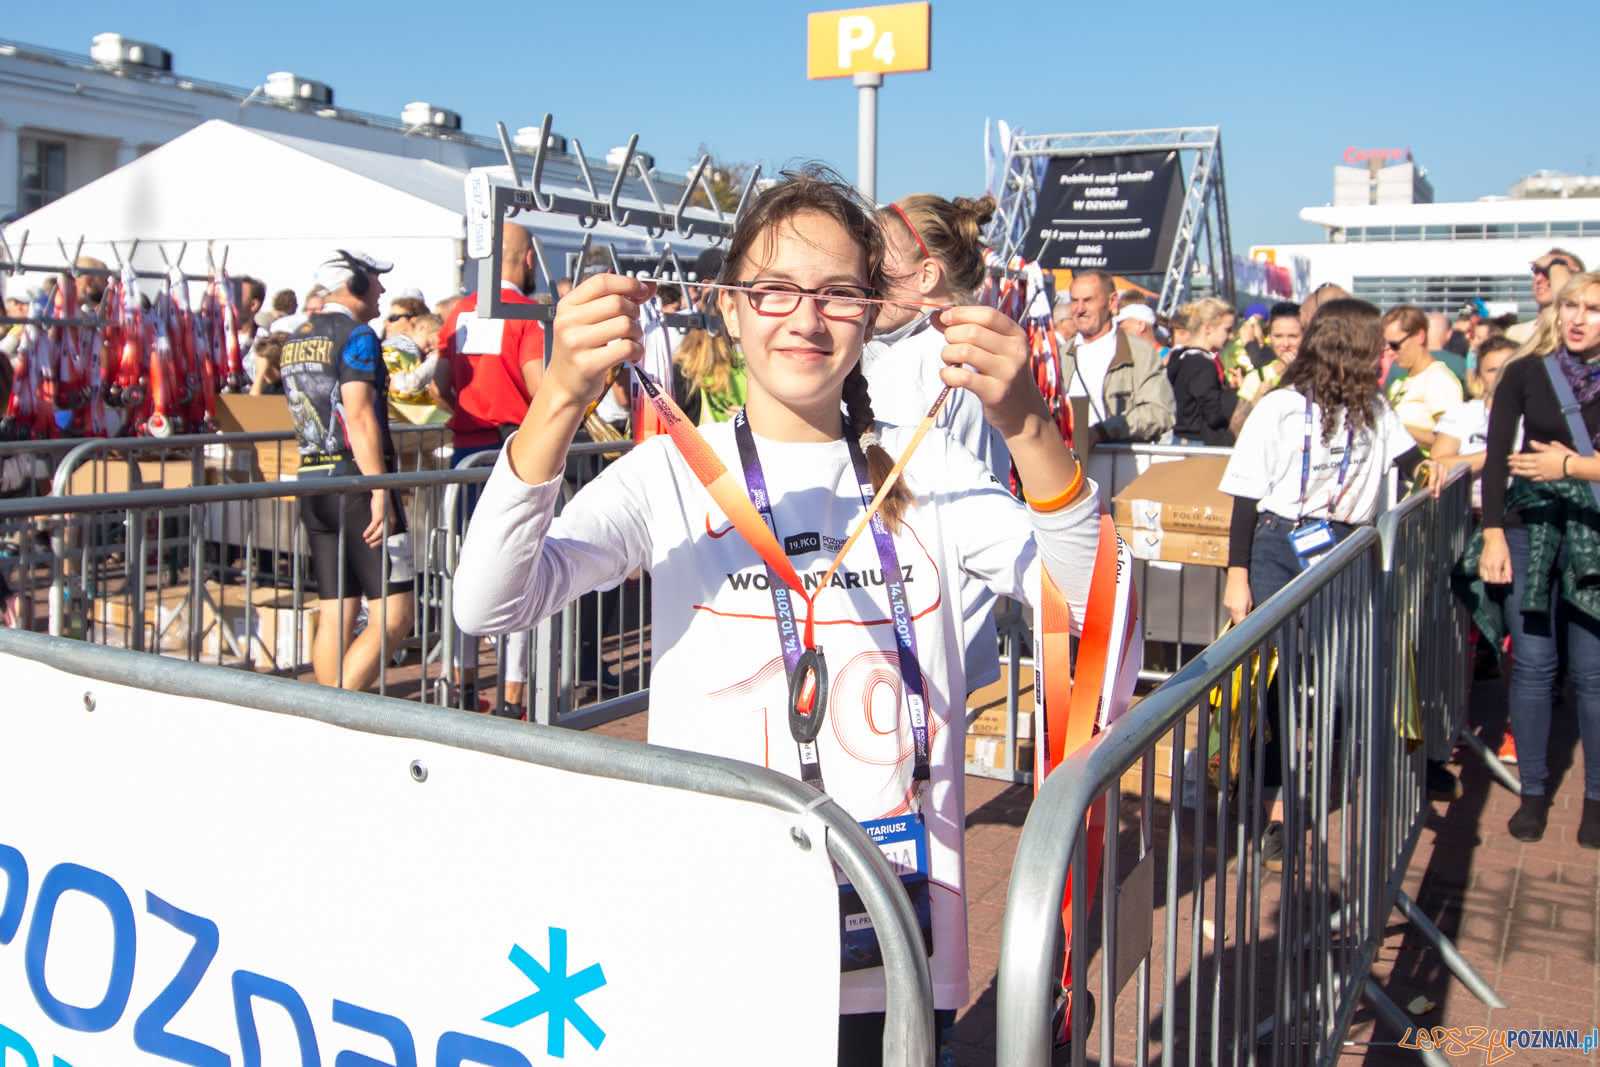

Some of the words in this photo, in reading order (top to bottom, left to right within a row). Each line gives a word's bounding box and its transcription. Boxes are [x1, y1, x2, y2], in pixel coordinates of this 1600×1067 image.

[838, 15, 896, 68] P4
[1058, 231, 1077, 241] you
[1078, 229, 1106, 239] break
[1106, 231, 1114, 239] a
[1060, 257, 1080, 266] THE
[727, 565, 914, 590] WONTARIUZ
[775, 588, 797, 653] 14.10.2018
[889, 581, 912, 647] 14.10.2018
[867, 822, 906, 836] TARIUSZ
